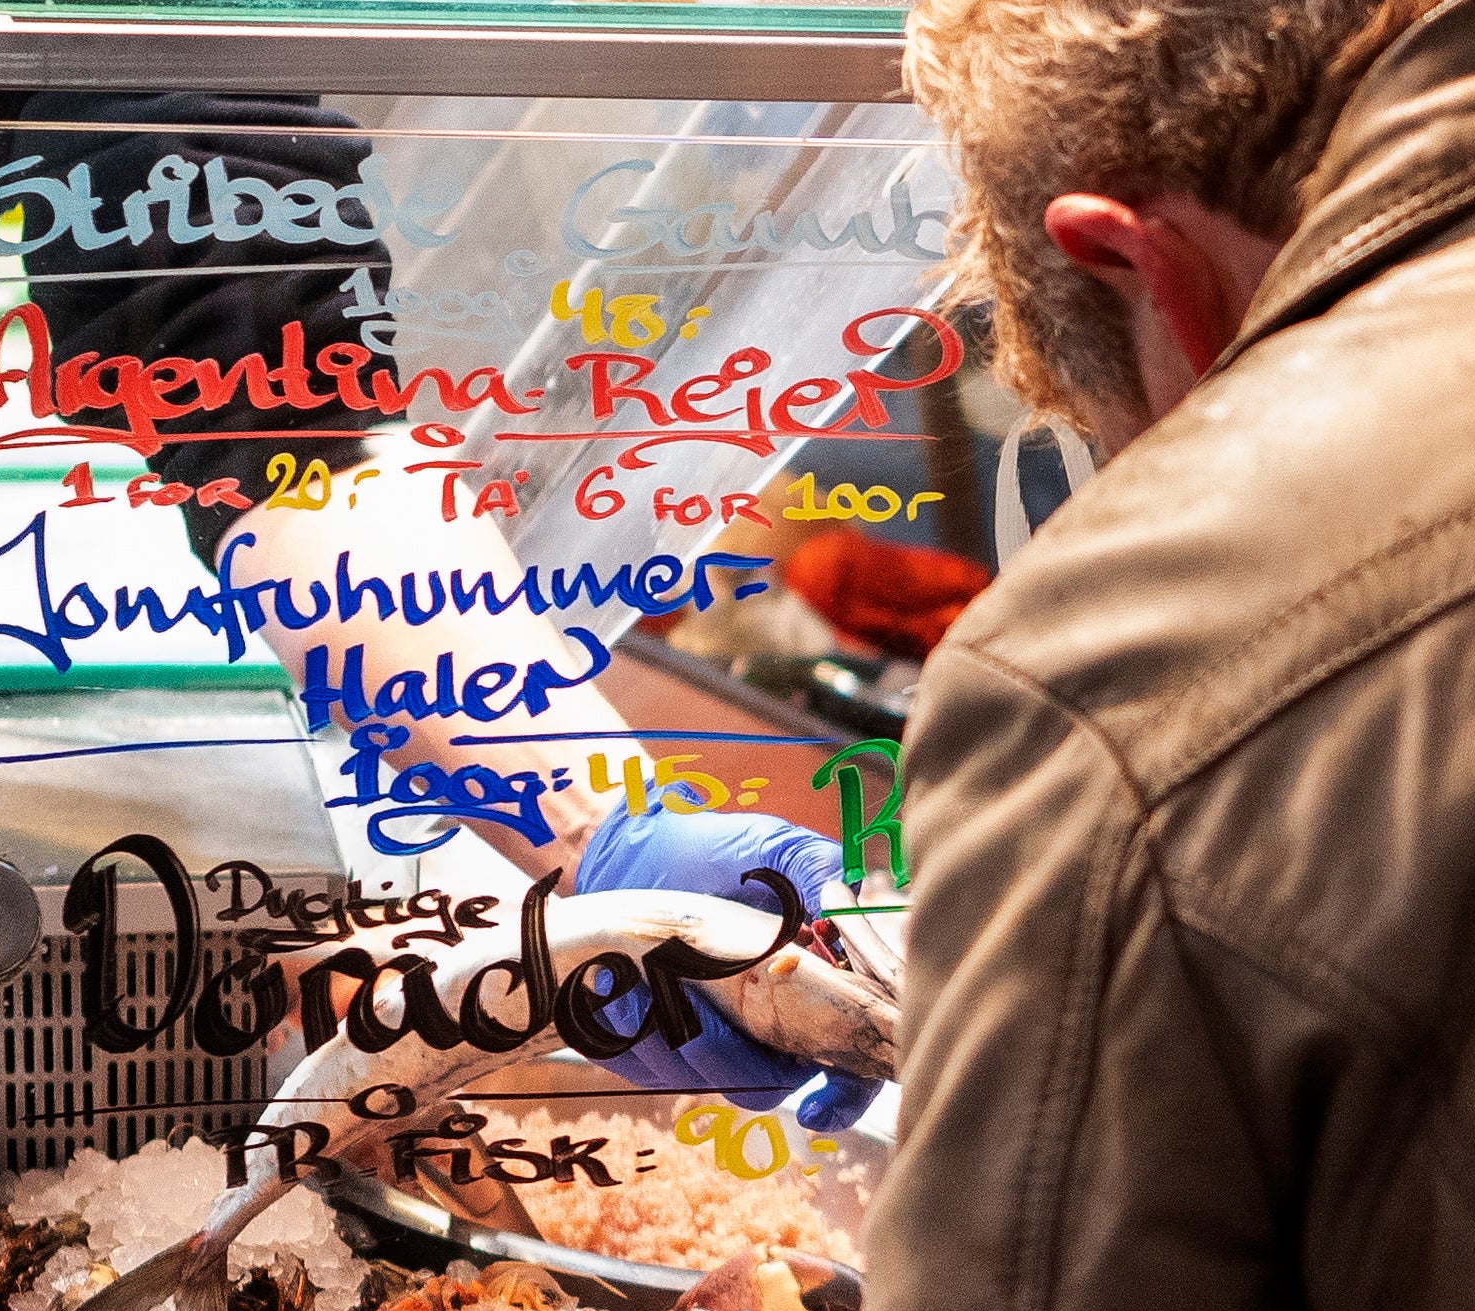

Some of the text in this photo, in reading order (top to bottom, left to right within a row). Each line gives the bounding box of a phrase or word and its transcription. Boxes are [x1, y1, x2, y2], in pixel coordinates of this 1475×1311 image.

[58, 460, 117, 509] 1
[574, 466, 626, 520] 6
[653, 487, 774, 530] FOR
[298, 625, 613, 735] Haler
[62, 831, 805, 1062] Dorader
